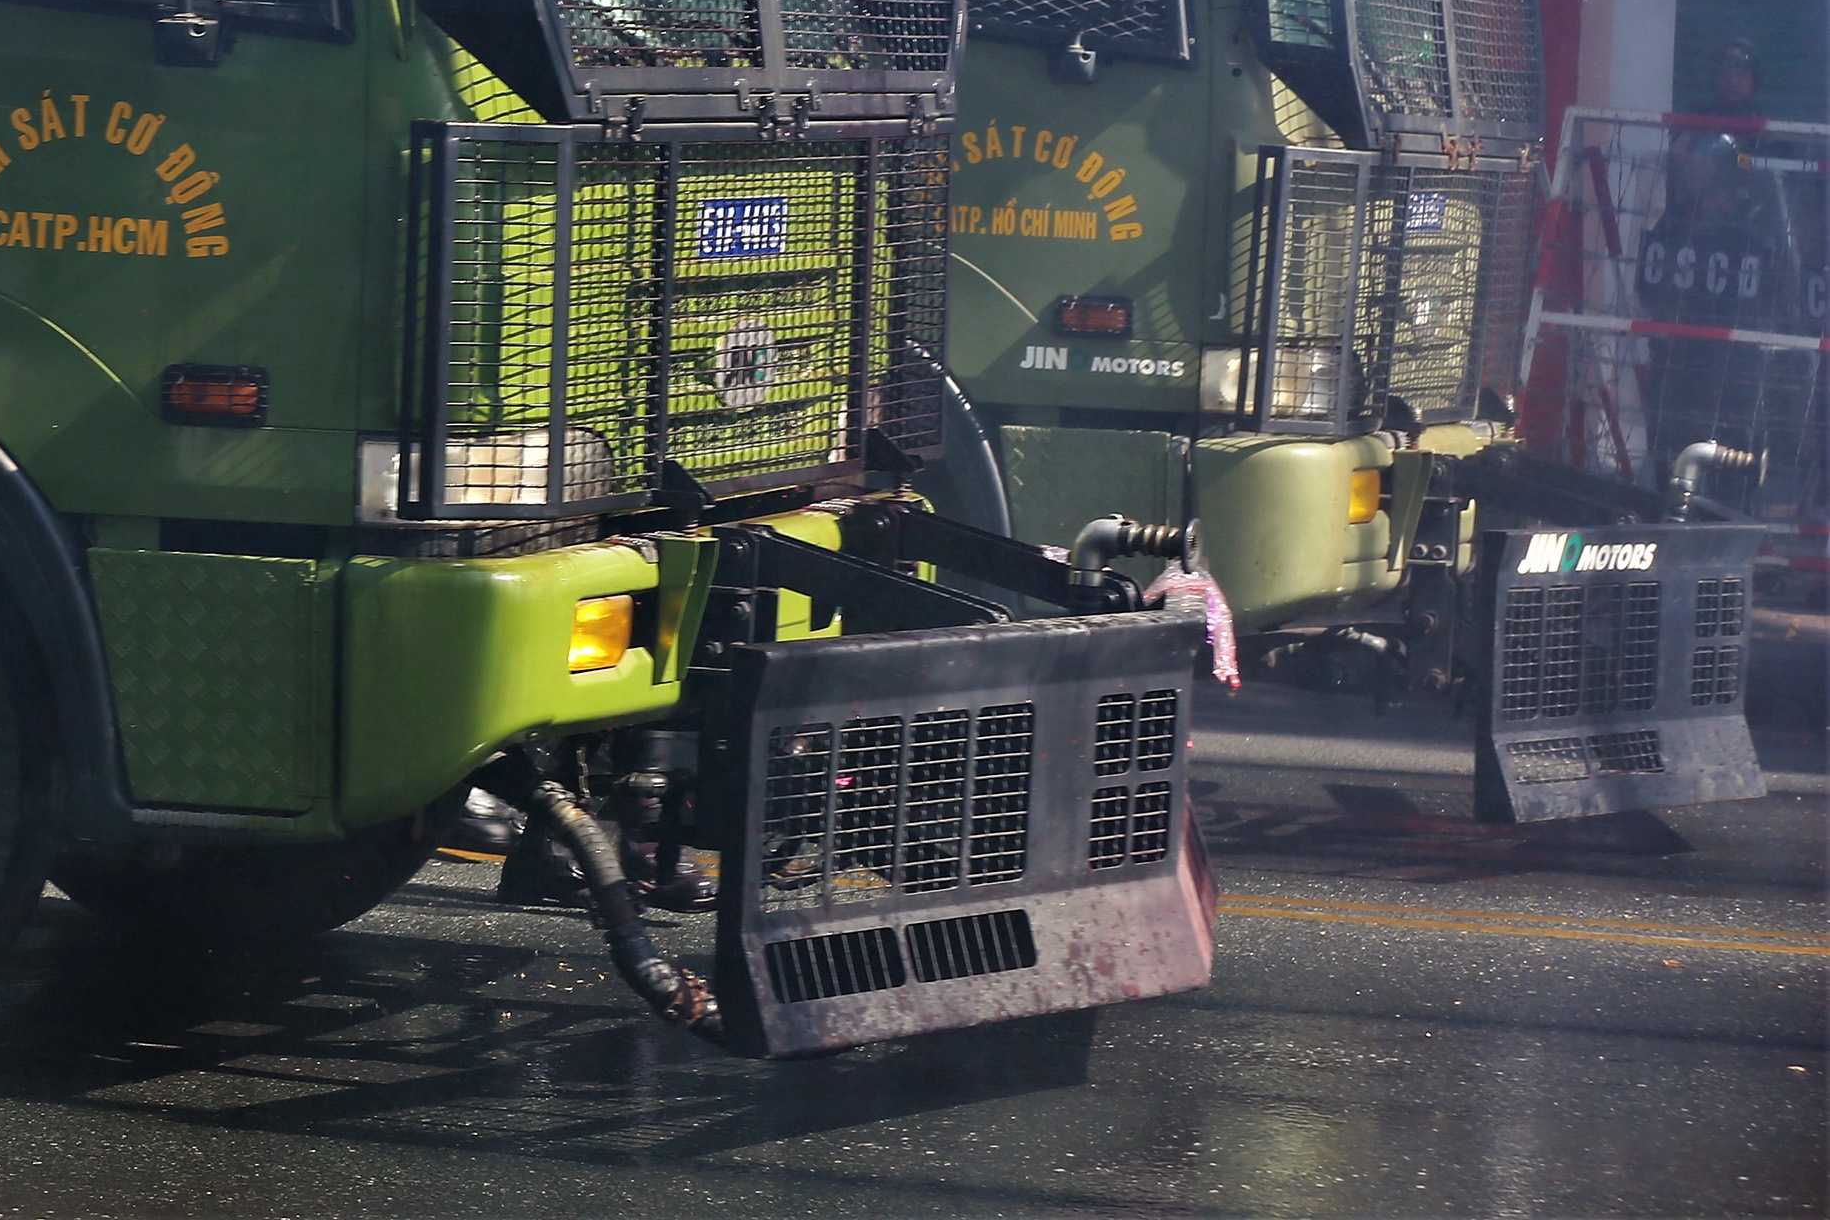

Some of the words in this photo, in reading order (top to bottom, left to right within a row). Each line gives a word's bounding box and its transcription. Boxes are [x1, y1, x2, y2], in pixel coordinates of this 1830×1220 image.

[10, 89, 90, 150] SÁT
[105, 101, 167, 155] CƠ
[155, 143, 229, 258] ĐỘNG
[962, 119, 1027, 164] SÁT
[1034, 130, 1079, 169] CƠ
[1076, 151, 1144, 241] ĐỘNG
[992, 197, 1018, 236] HỒ
[1021, 203, 1052, 237] CHÍ
[1053, 209, 1098, 240] MINH
[1643, 241, 1762, 299] CSCĐ
[1089, 356, 1185, 378] MOTORS
[1575, 543, 1658, 571] MOTORS
